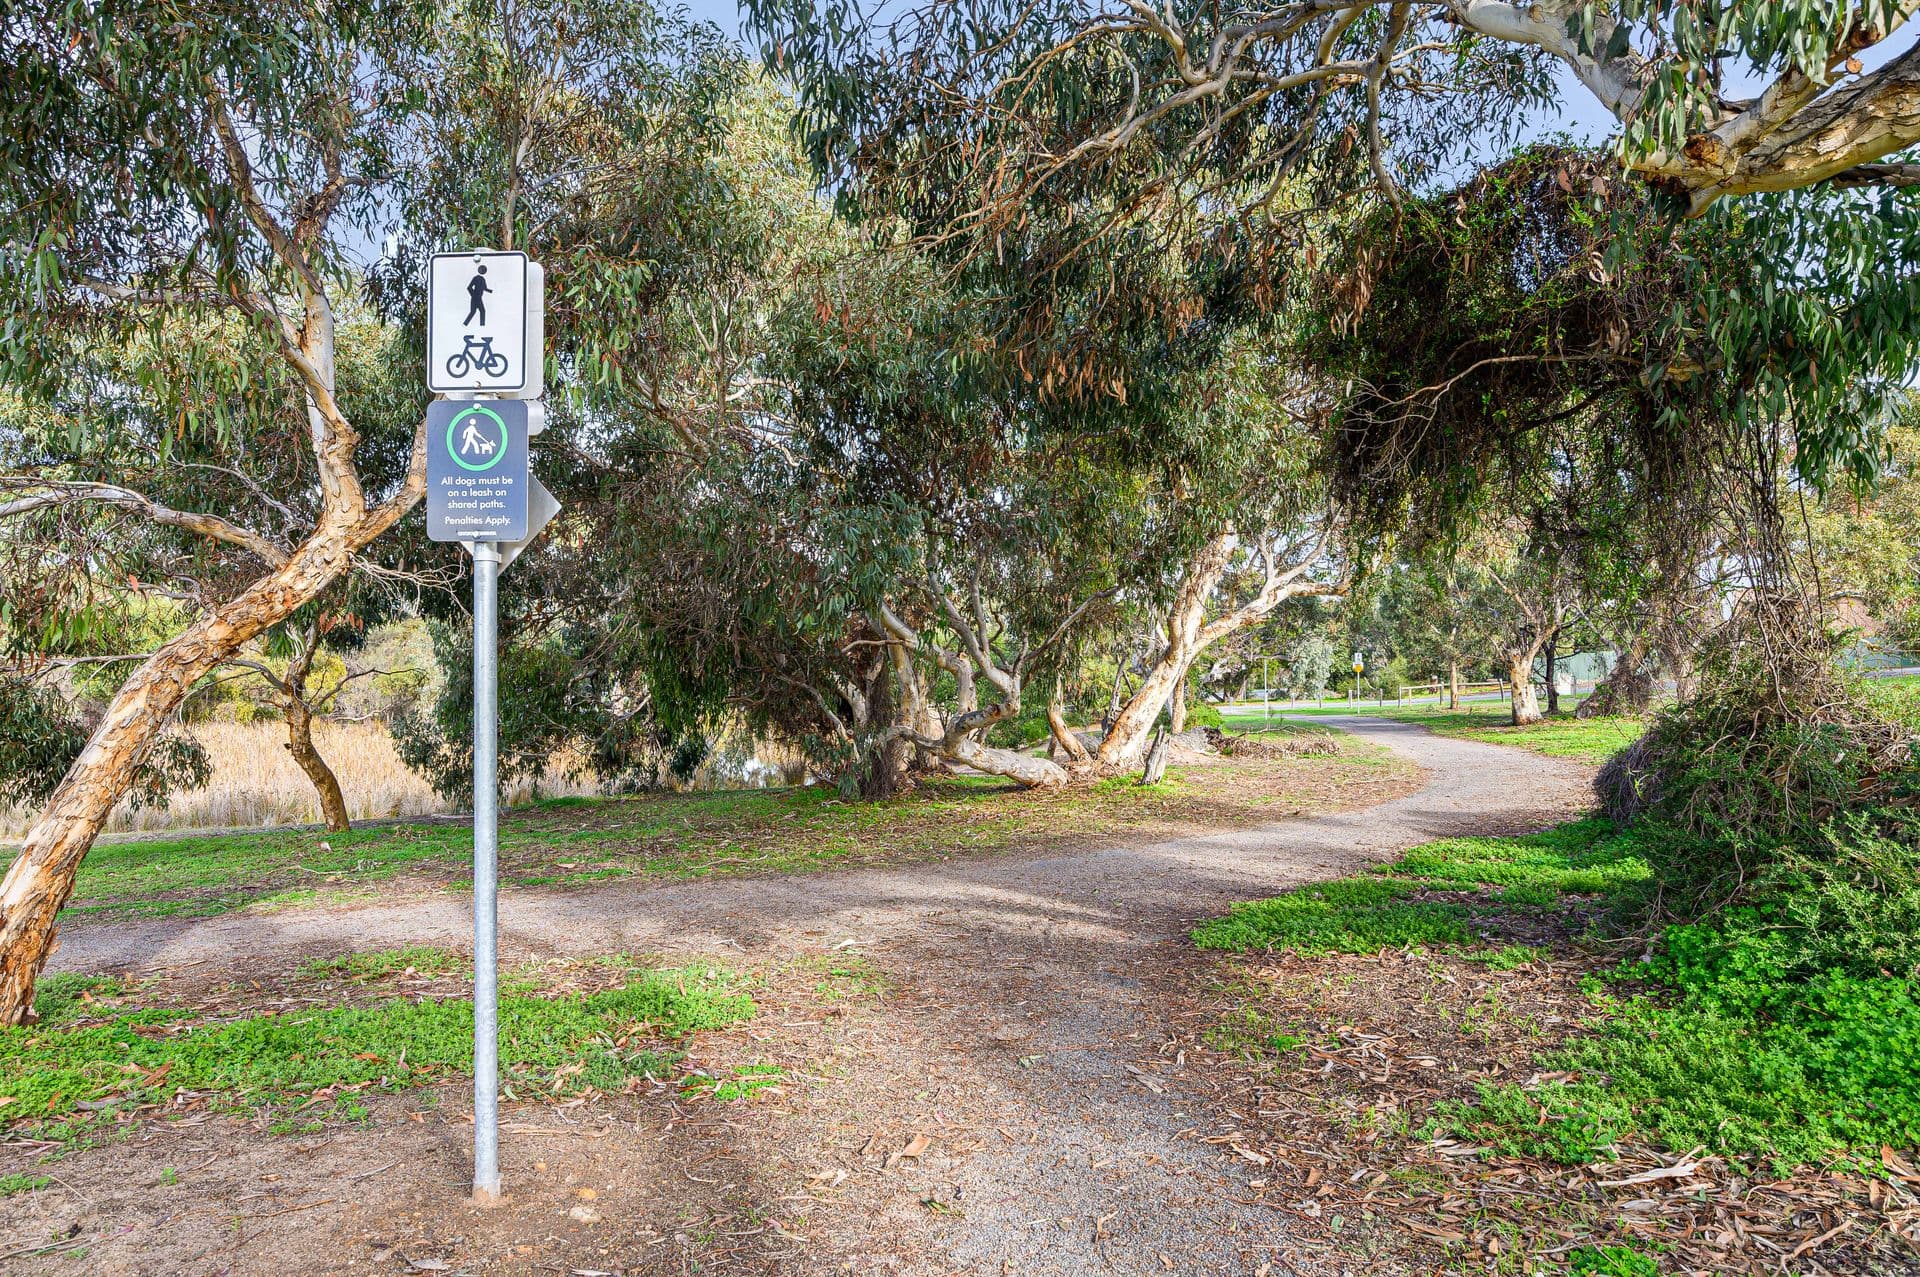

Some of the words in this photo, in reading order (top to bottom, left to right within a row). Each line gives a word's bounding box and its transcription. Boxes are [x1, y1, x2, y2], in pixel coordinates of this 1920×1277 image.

[441, 477, 453, 485] All
[455, 476, 476, 486] dogs
[502, 476, 513, 484] be
[470, 488, 492, 496] leash
[448, 500, 477, 508] shared
[480, 500, 506, 510] paths.
[444, 516, 483, 524] Penalties
[485, 516, 511, 526] Apply.
